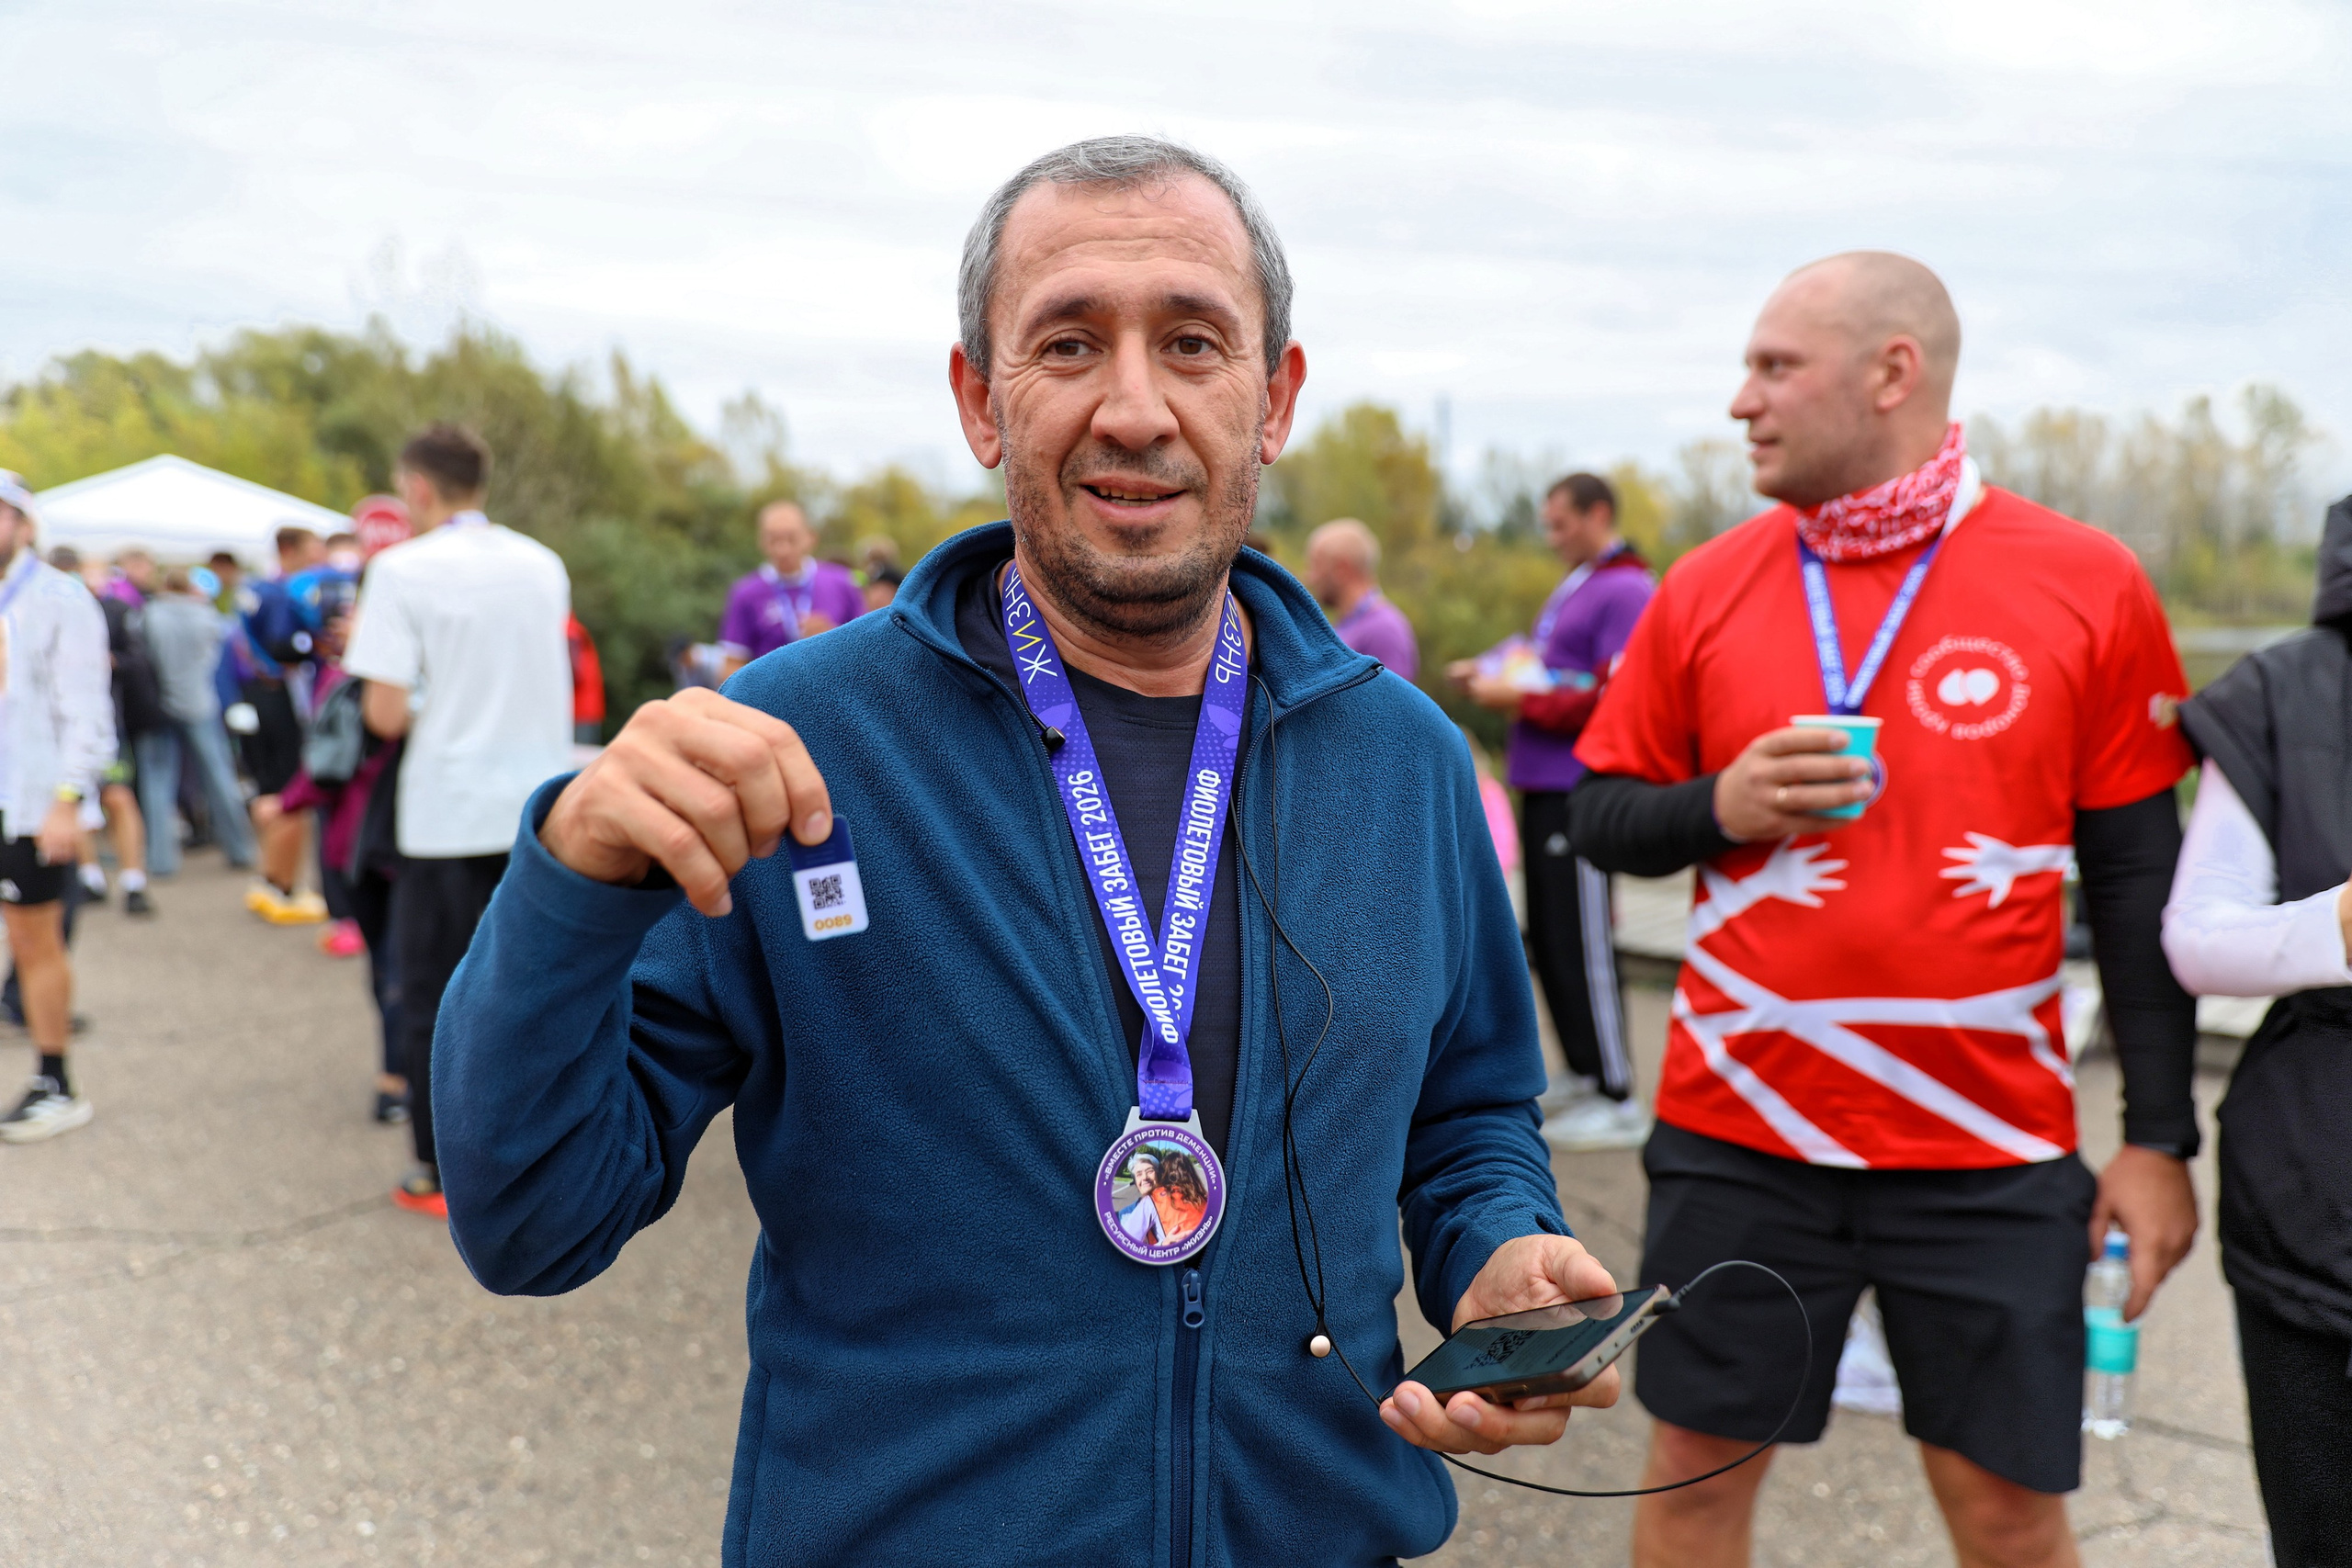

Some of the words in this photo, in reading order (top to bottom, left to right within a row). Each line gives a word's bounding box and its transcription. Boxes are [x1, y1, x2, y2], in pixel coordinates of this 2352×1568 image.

[1005, 567, 1058, 685] ЖИЗНЬ
[1215, 590, 1242, 683] ИЗНЬ
[1068, 769, 1108, 826] 2026
[1085, 830, 1129, 894] ЗАБЕГ
[1173, 768, 1222, 911] ФИОЛЕТОВЫЙ
[814, 914, 854, 931] 0089
[1162, 911, 1196, 980] ЗАБЕГ
[1104, 896, 1180, 1045] ФИОЛЕТОВЫЙ
[1105, 1137, 1135, 1180] «ВМЕСТЕ
[1135, 1129, 1175, 1143] ПРОТИВ
[1175, 1133, 1217, 1185] ДЕМЕНЦИИ»
[1103, 1211, 1148, 1256] РЕСУРСНЫЙ
[1148, 1247, 1181, 1258] ЦЕНТР
[1181, 1215, 1214, 1252] «ЖИЗНЬ»
